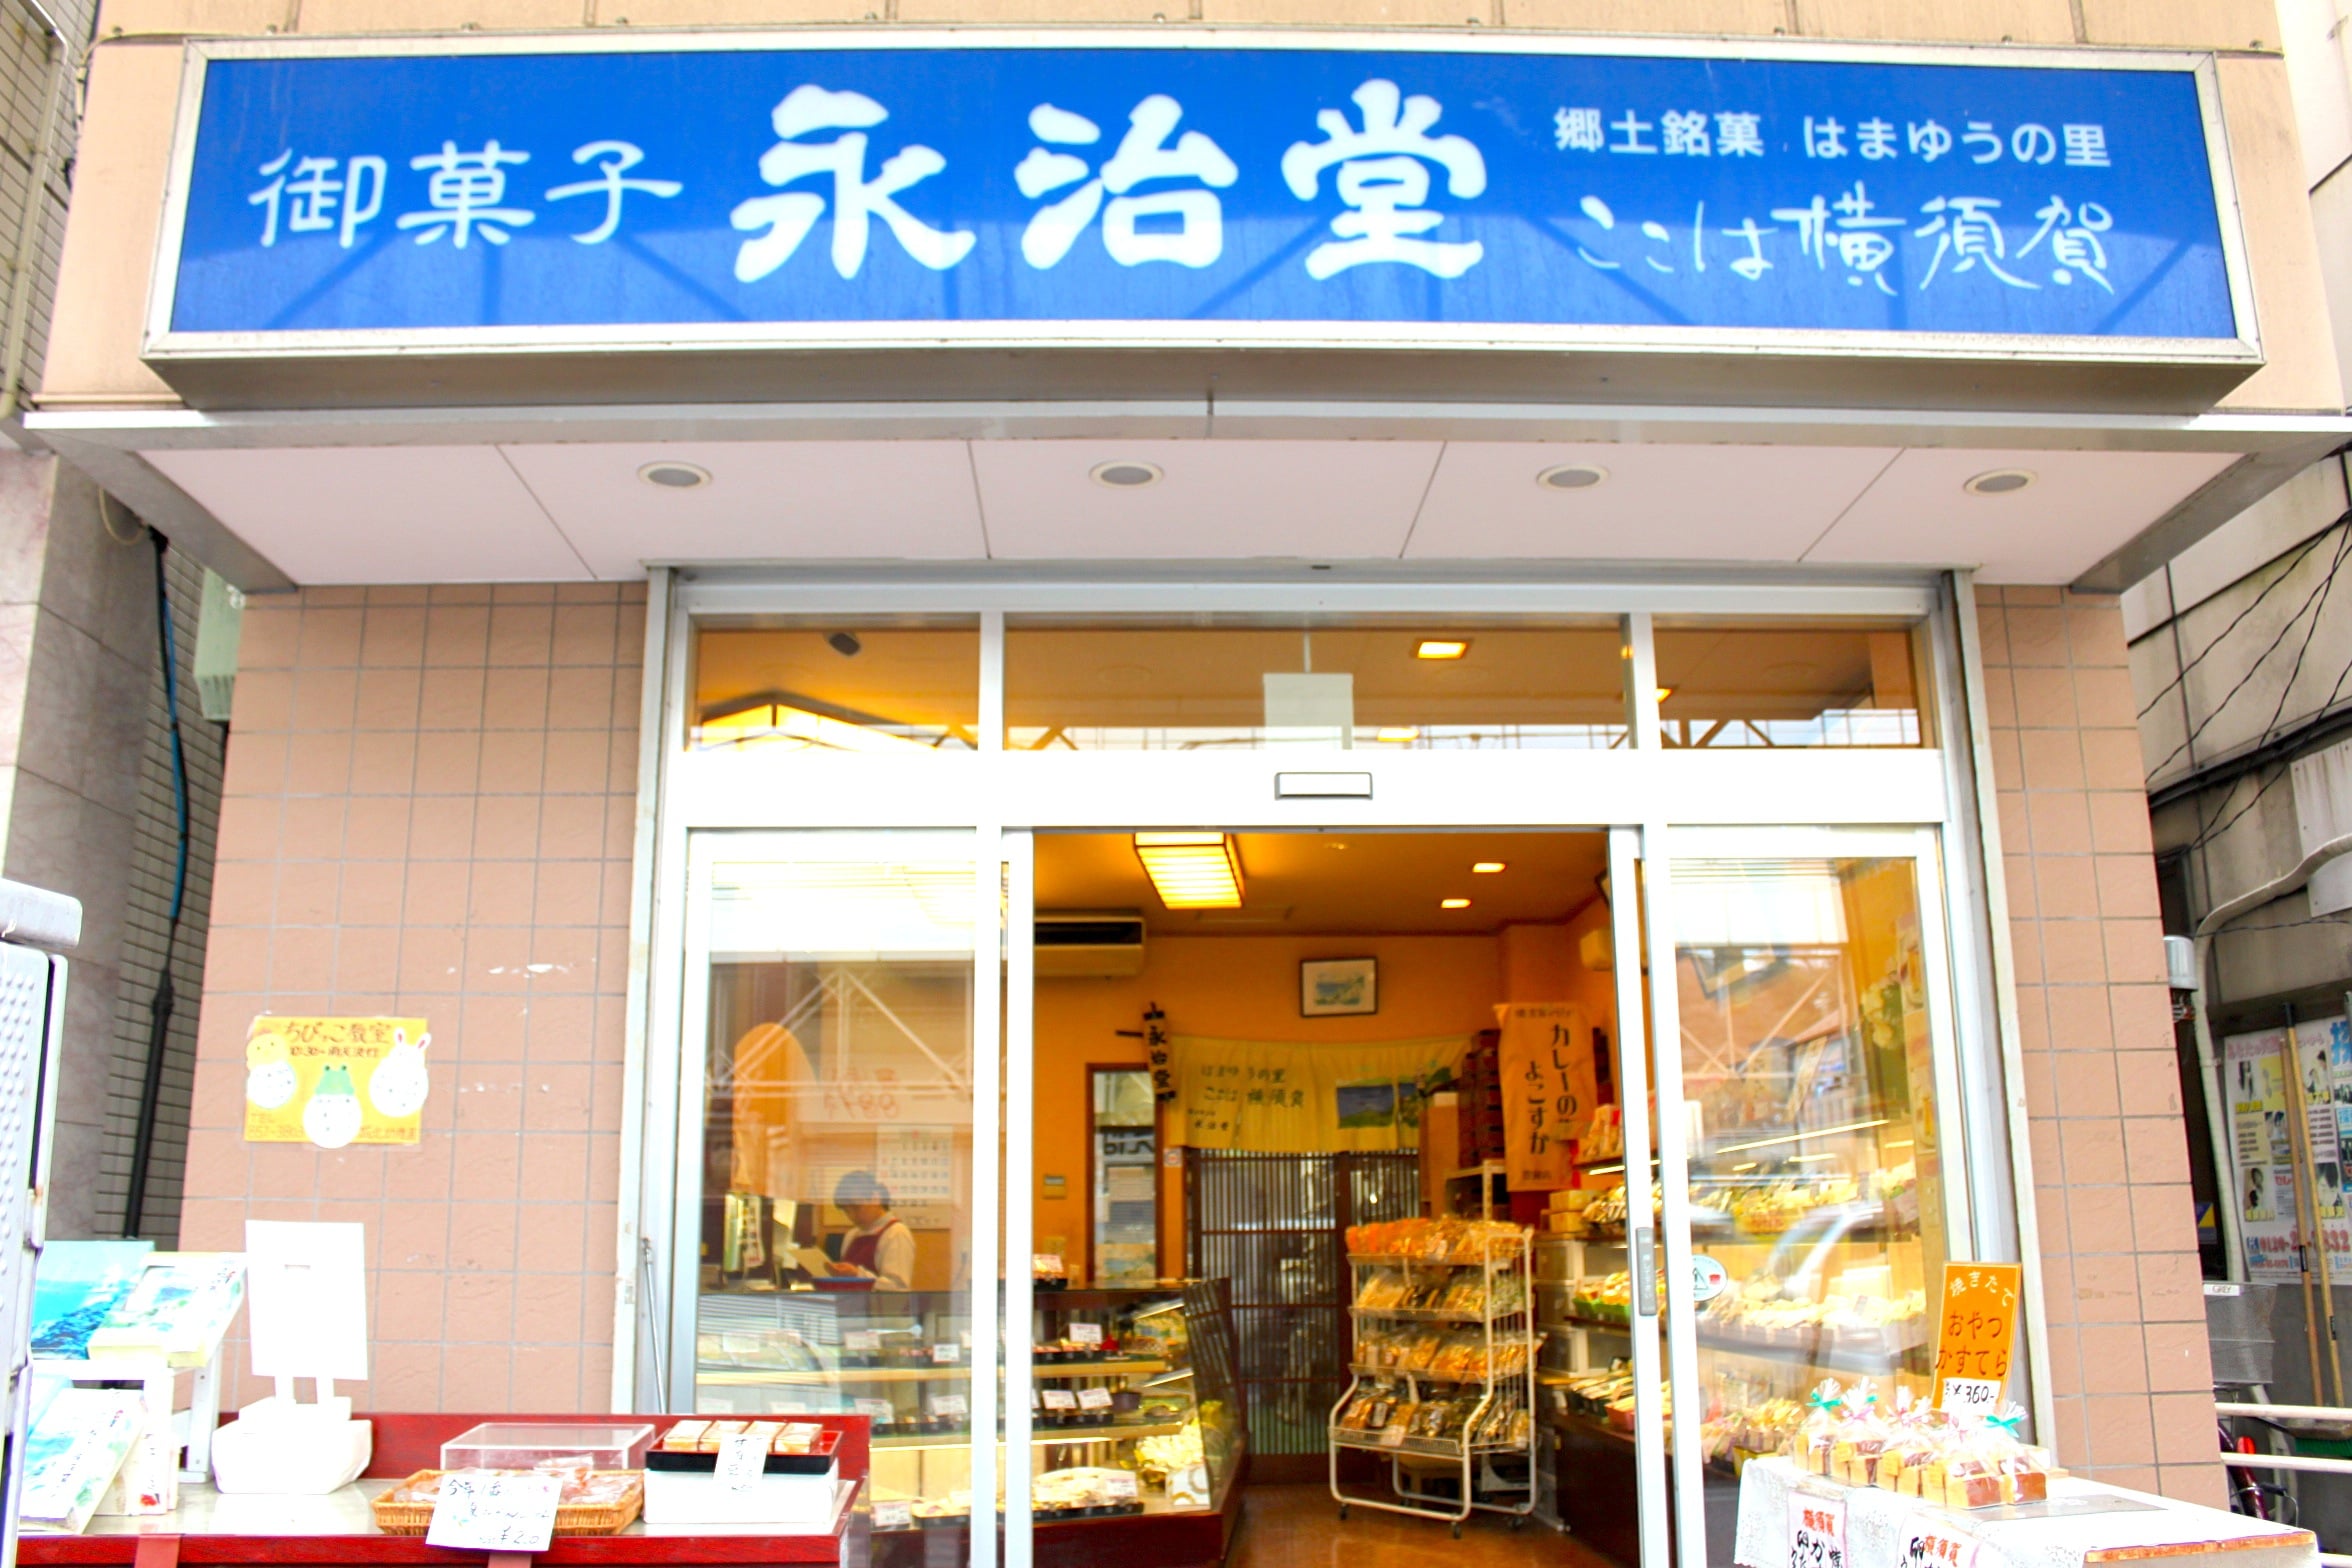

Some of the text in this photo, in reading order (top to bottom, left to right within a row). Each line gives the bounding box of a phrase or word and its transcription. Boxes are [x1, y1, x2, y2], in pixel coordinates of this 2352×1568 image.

[1553, 106, 2112, 168] 郷土銘菓 はまゆうの里
[248, 77, 1488, 285] 御菓子 永治堂
[1577, 180, 2116, 297] ここは横須賀
[1949, 1270, 2015, 1308] 焼きたて
[1948, 1310, 2003, 1340] おやつ
[1935, 1344, 2008, 1377] かすてら
